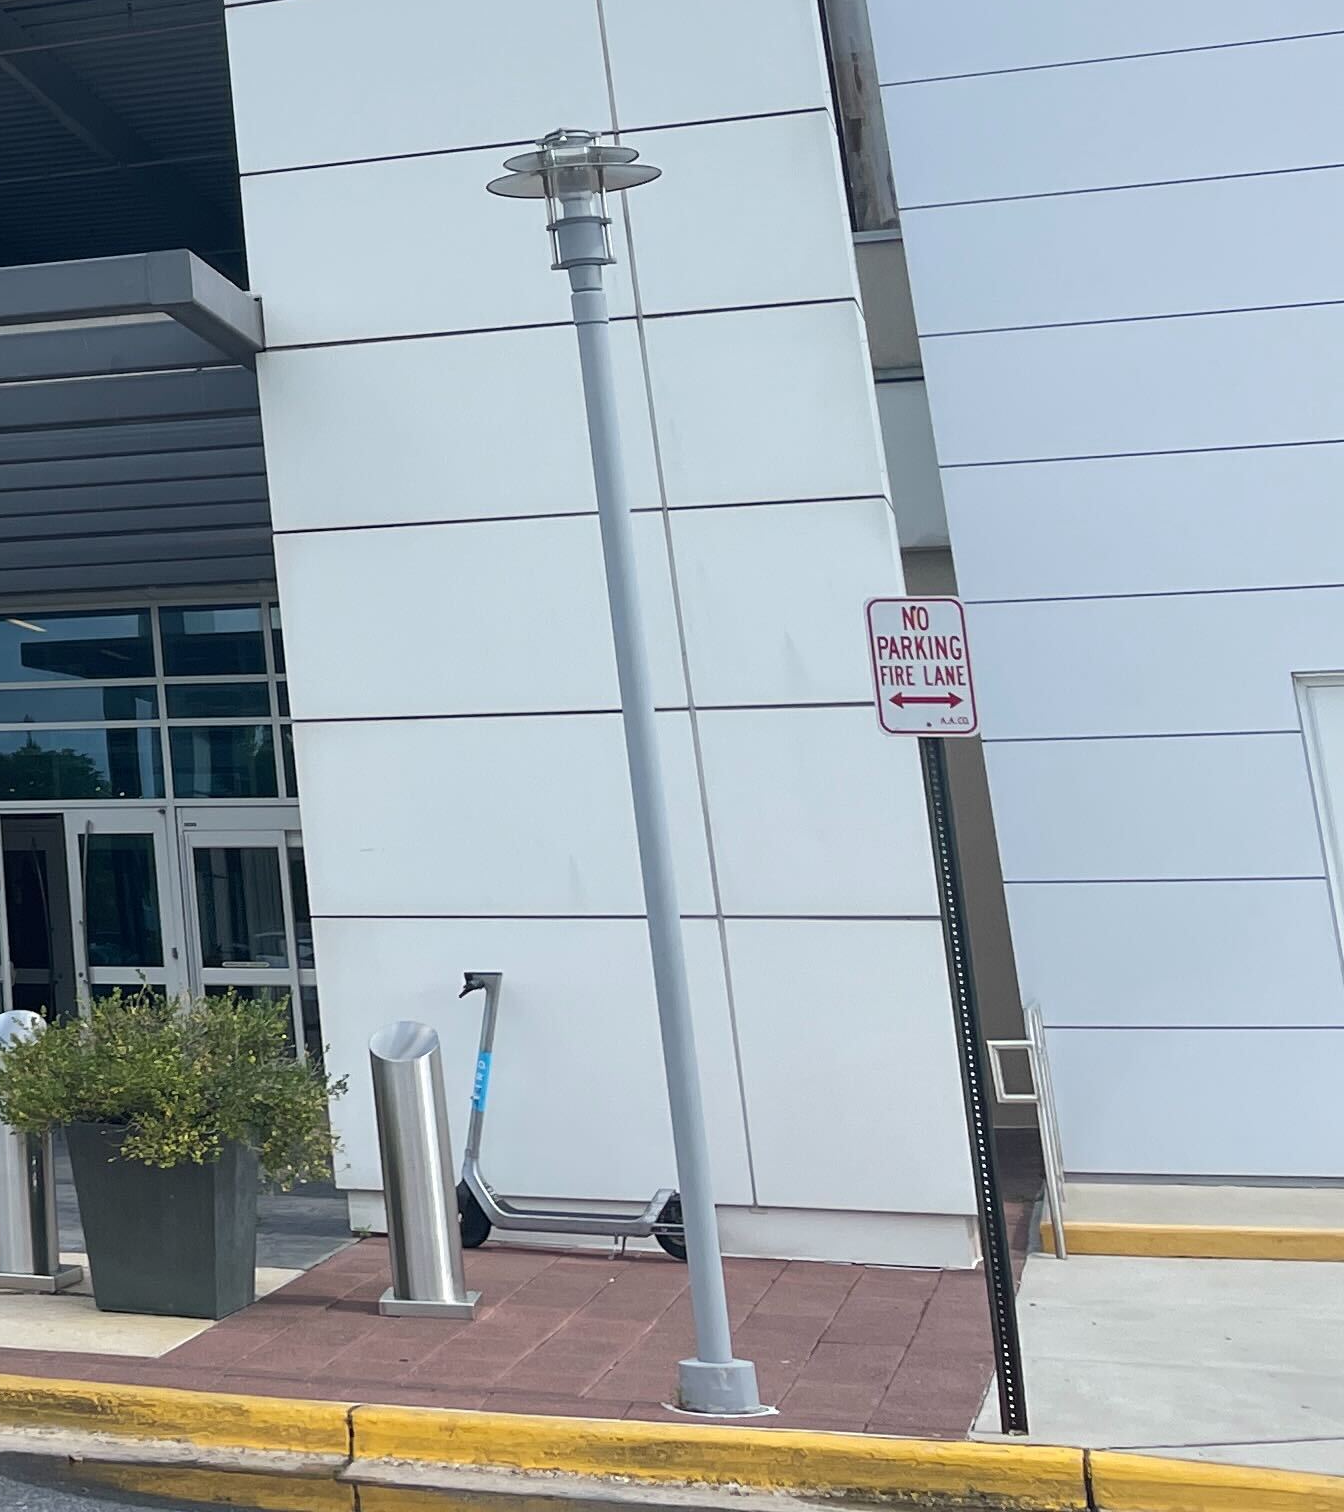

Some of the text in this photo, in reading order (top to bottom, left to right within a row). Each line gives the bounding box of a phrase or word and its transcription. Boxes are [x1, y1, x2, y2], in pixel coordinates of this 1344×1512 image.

[901, 606, 929, 631] NO
[877, 635, 962, 661] PARKING
[880, 665, 967, 686] FIRE LANE
